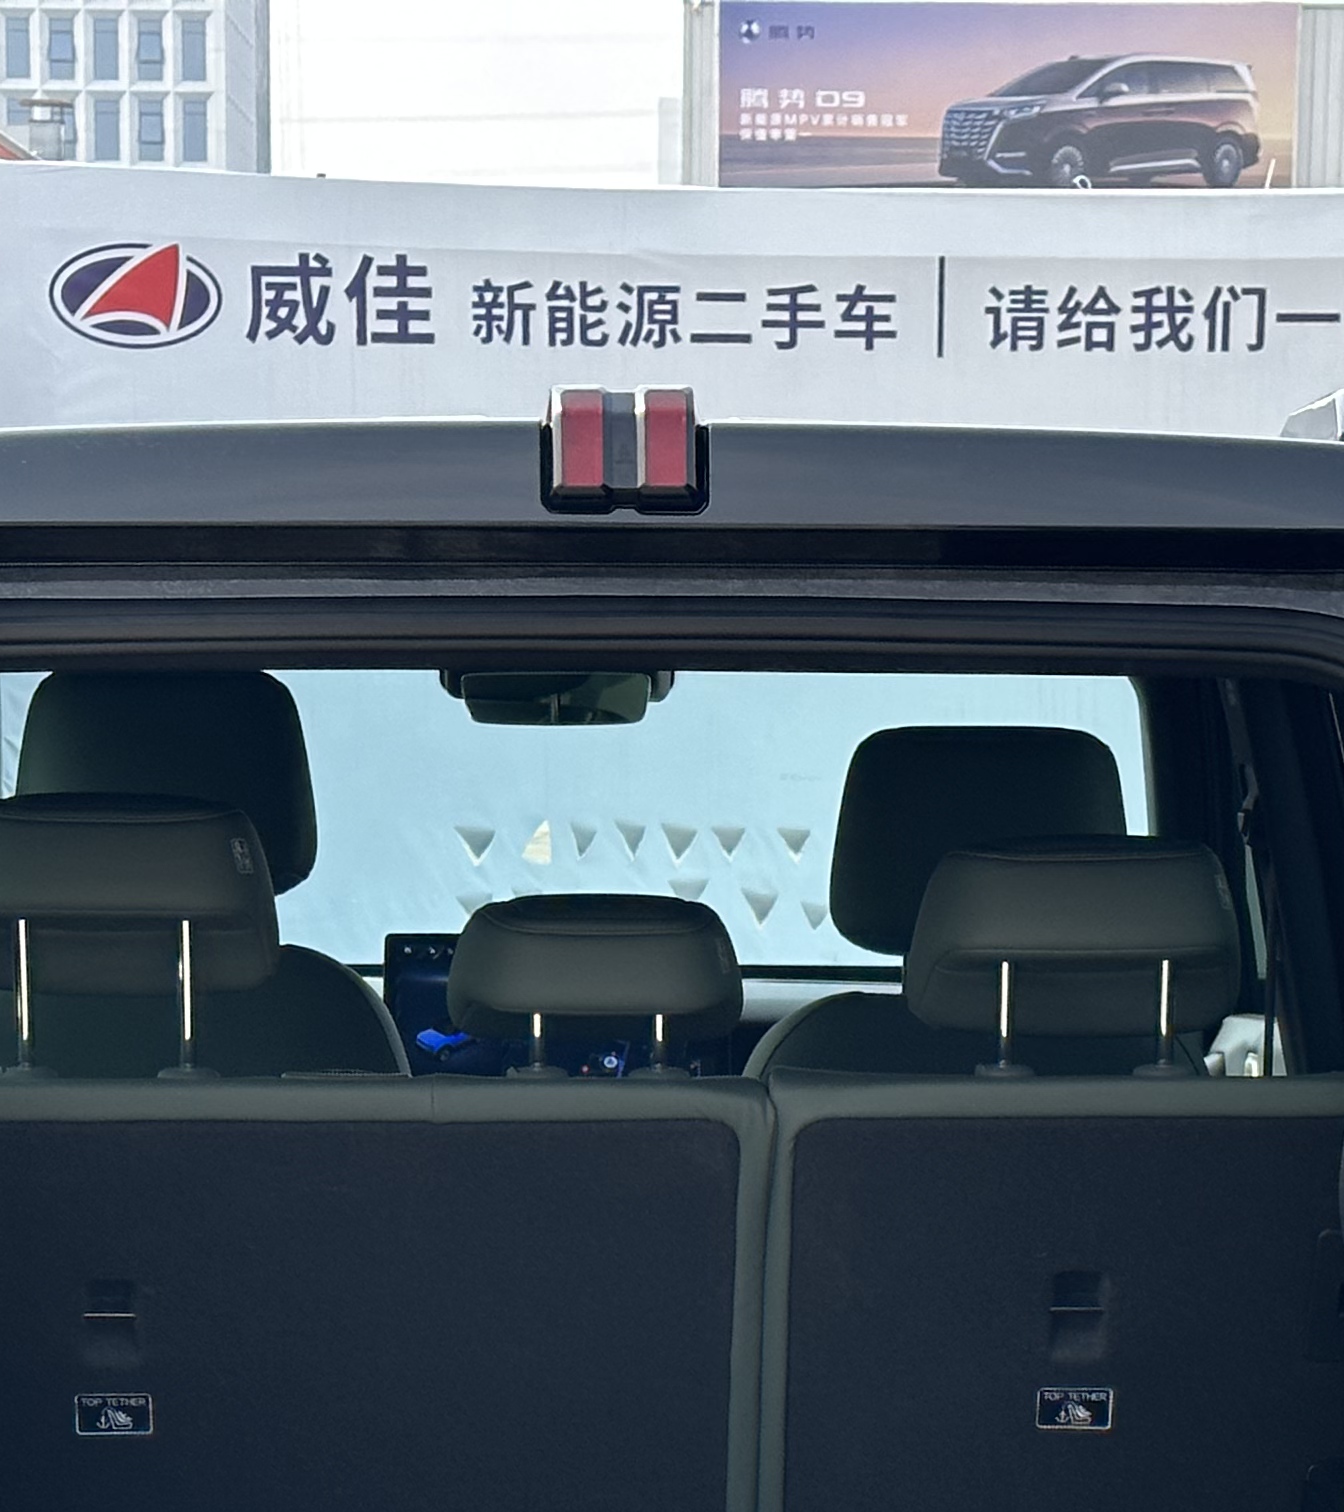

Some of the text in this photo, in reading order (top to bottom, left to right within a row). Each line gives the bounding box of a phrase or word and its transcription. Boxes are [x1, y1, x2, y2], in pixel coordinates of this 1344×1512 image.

[740, 88, 805, 109] 腾势
[245, 253, 436, 347] 威佳
[471, 279, 899, 352] 新能源二手车
[81, 1397, 103, 1407] TOP
[1043, 1391, 1109, 1402] TOP TETHER
